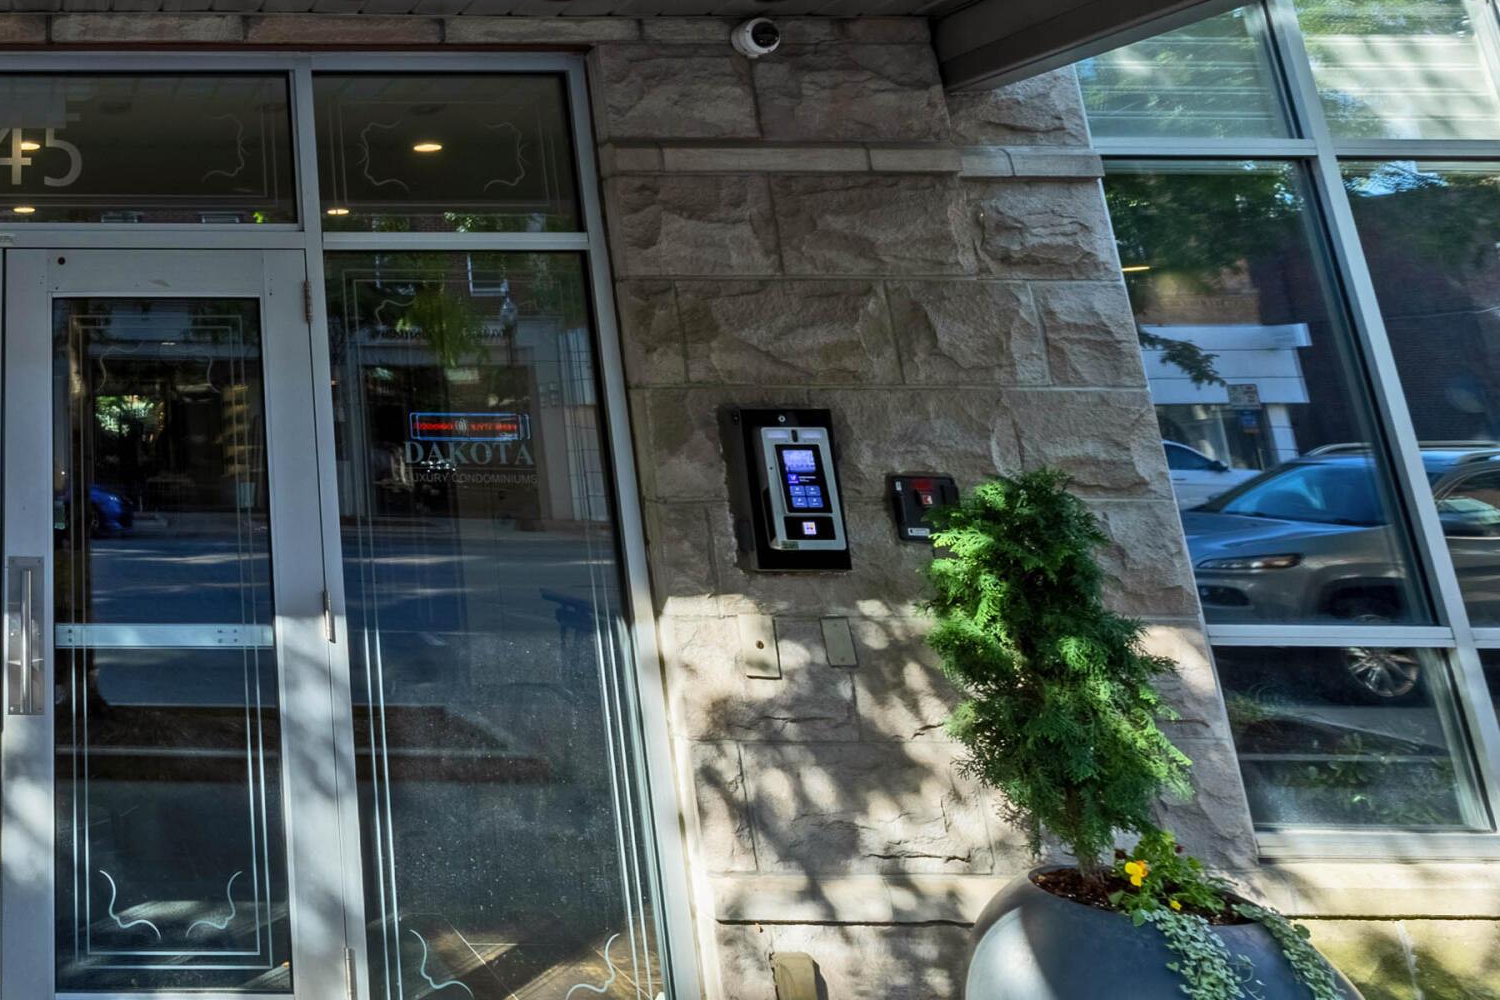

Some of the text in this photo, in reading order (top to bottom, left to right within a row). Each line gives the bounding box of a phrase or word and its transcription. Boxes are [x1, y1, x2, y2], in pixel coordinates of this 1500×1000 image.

[404, 440, 535, 465] DAKOTA
[408, 472, 539, 484] LUXURY CONDOMINIUMS
